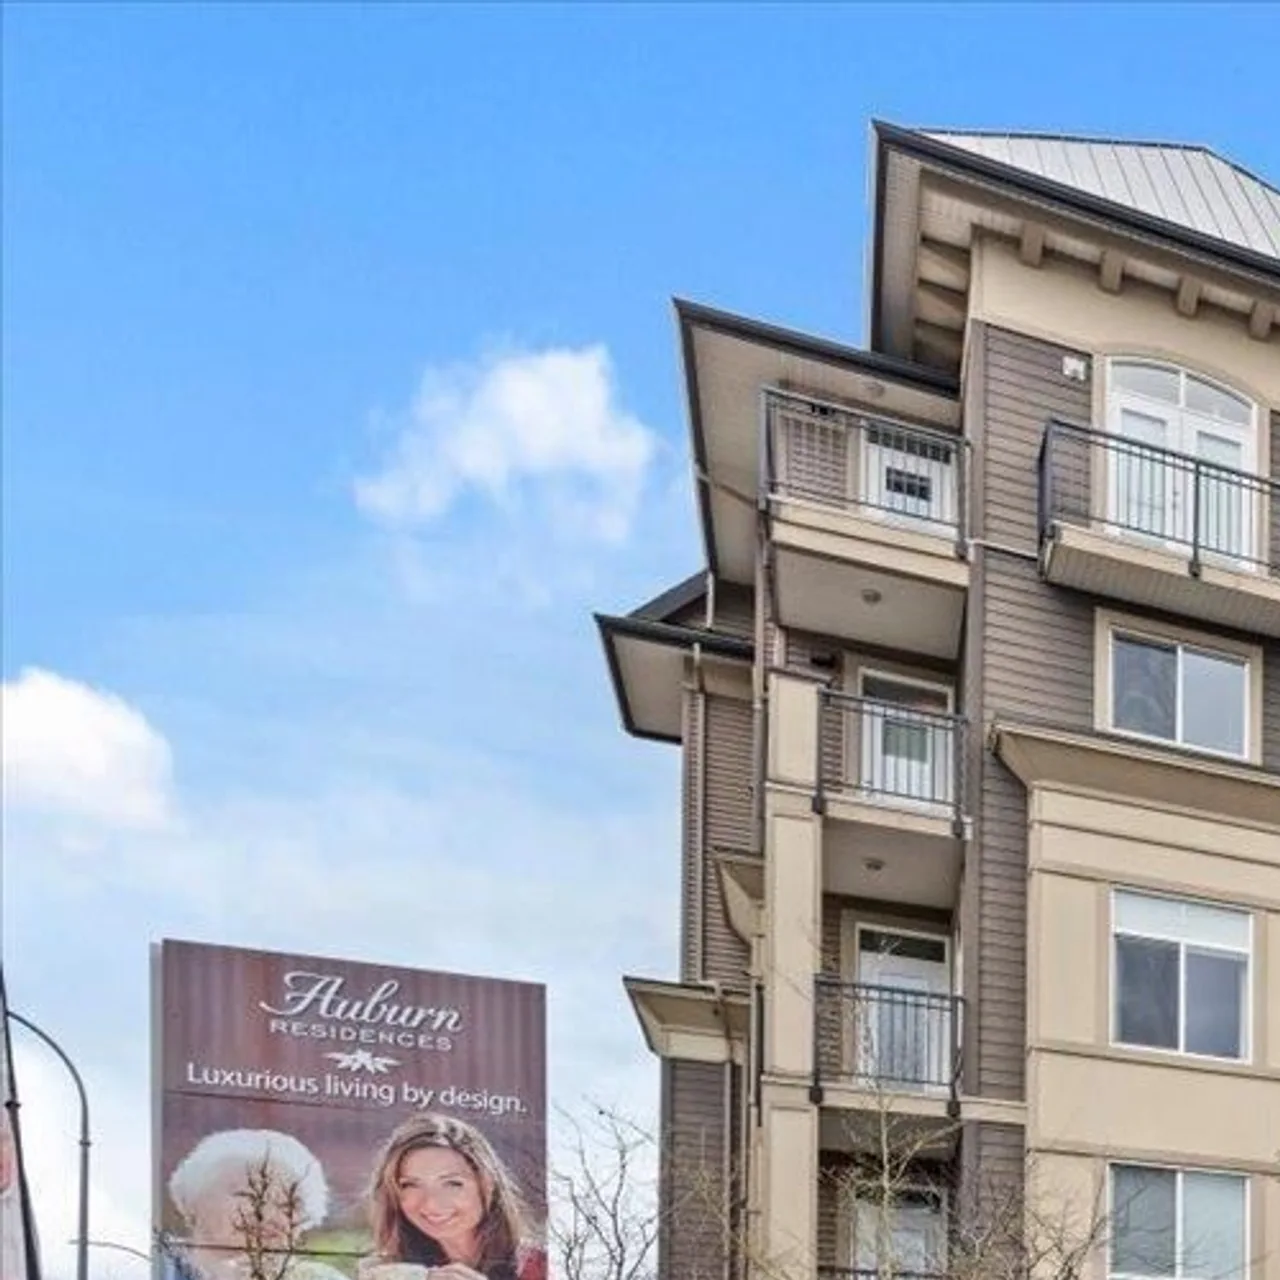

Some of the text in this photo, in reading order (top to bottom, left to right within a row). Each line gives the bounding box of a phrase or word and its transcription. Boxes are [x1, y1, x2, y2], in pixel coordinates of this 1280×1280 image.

[258, 970, 464, 1033] Auburn
[269, 1018, 453, 1051] RESIDENCES
[187, 1062, 527, 1116] Luxurious living by design.
